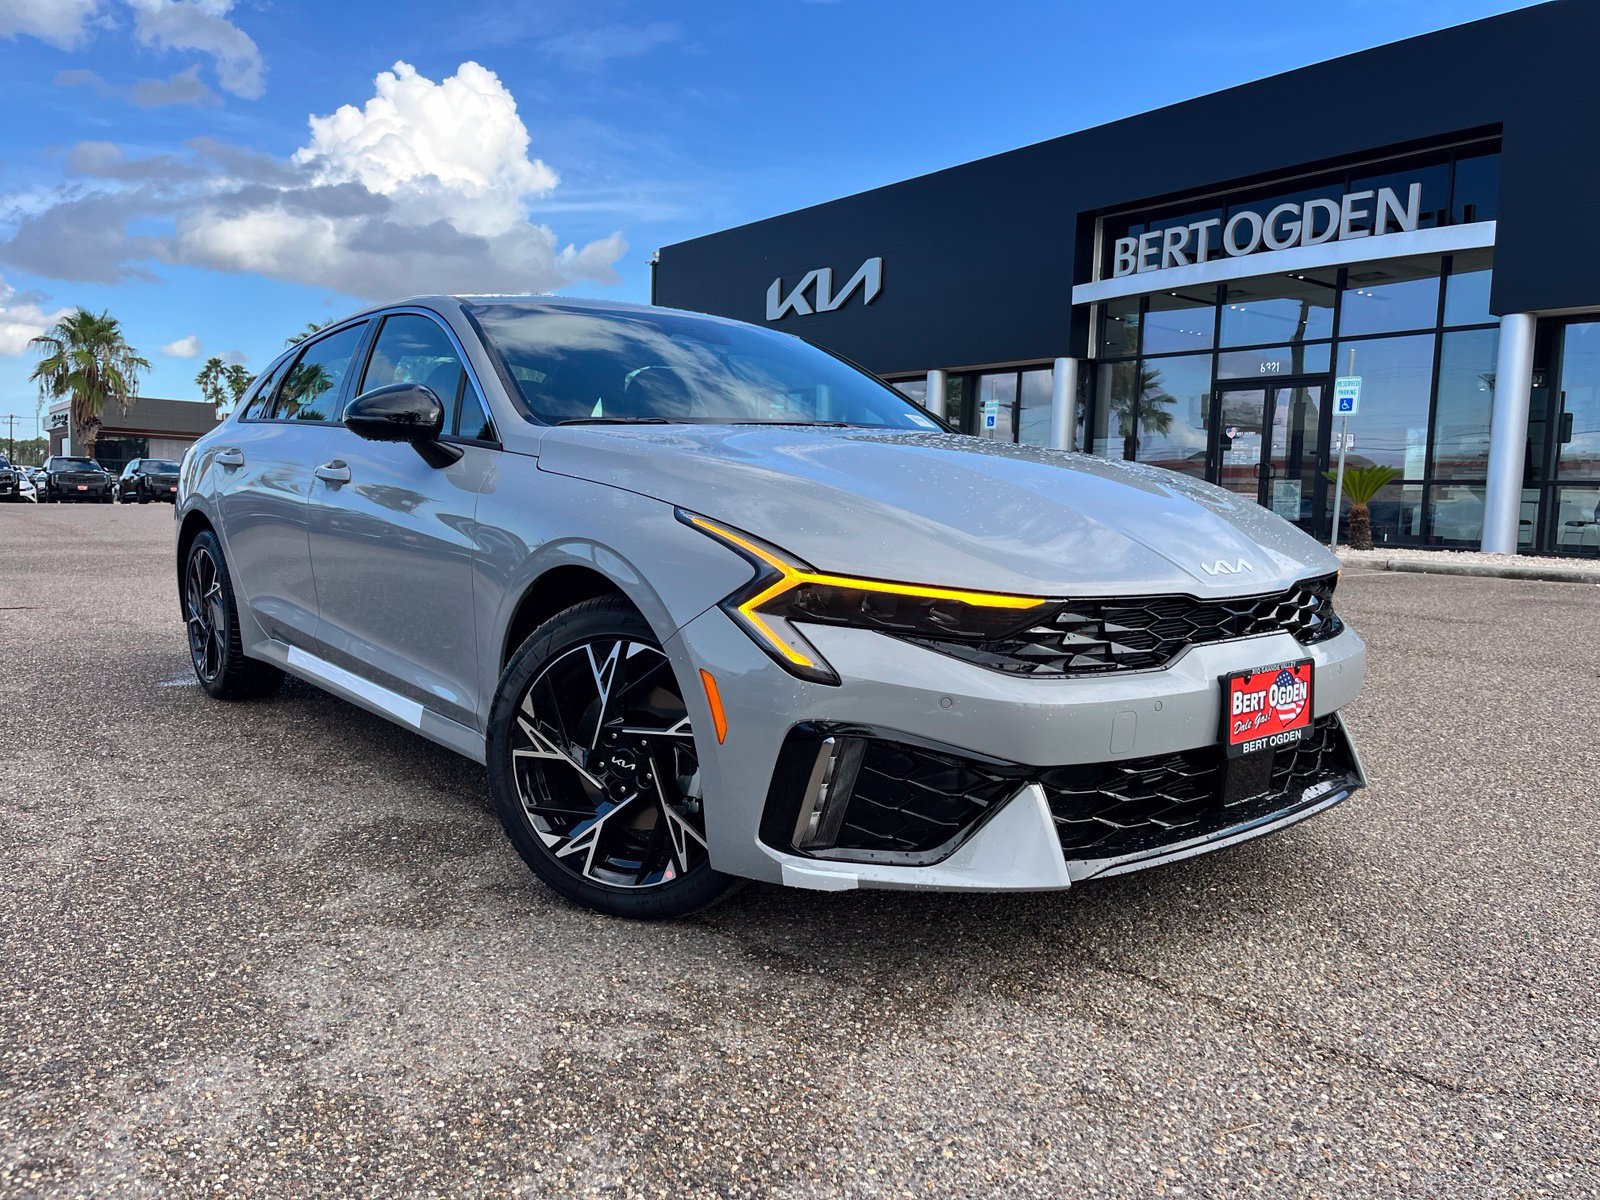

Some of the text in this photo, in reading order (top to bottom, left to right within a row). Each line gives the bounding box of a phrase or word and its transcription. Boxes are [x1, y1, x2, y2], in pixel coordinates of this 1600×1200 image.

[1113, 182, 1422, 278] BERT OGDEN
[766, 257, 882, 321] KIA
[1233, 682, 1307, 715] BERT OGDEN
[1233, 720, 1252, 735] Dale
[1243, 729, 1301, 753] BERT OGDEN
